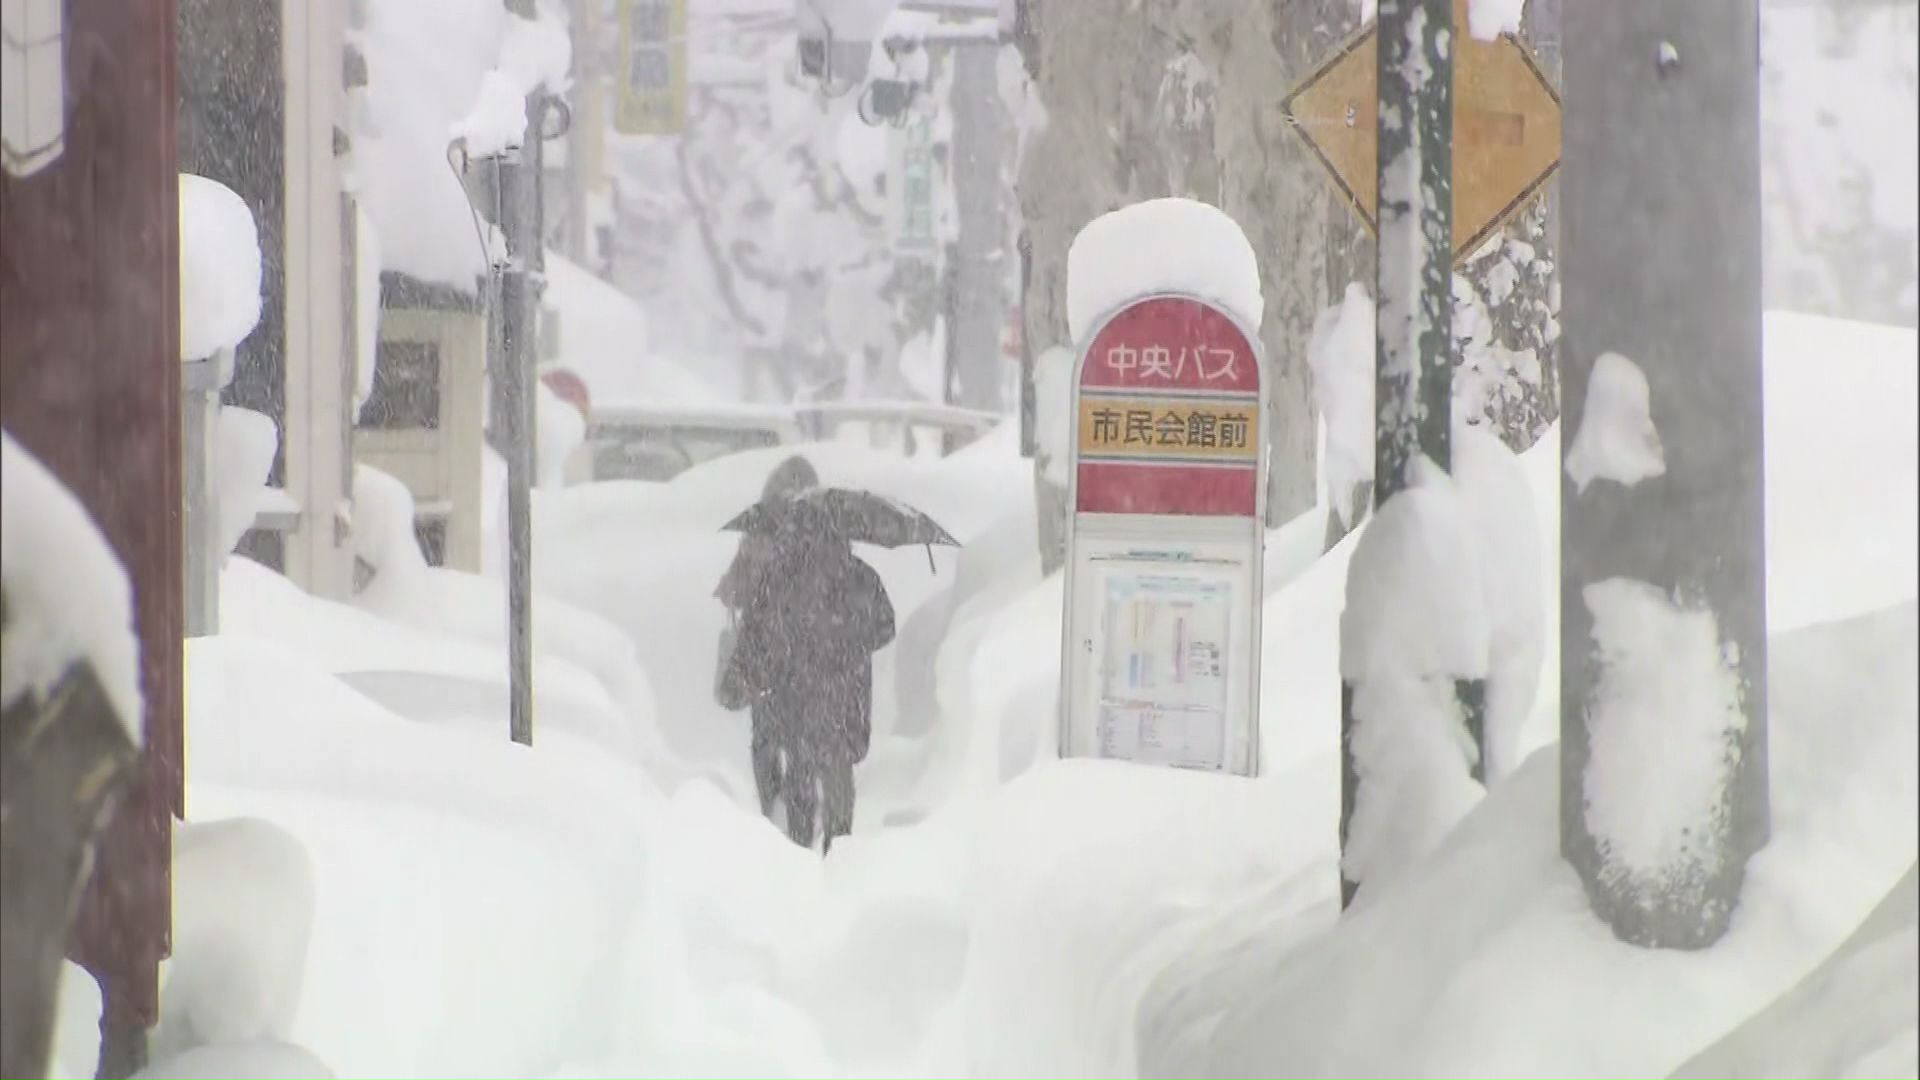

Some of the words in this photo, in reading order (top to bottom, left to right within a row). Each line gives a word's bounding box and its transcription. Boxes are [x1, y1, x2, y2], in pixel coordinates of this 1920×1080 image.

[1107, 342, 1239, 381] 中央バス
[1091, 407, 1250, 449] 市民会館前
